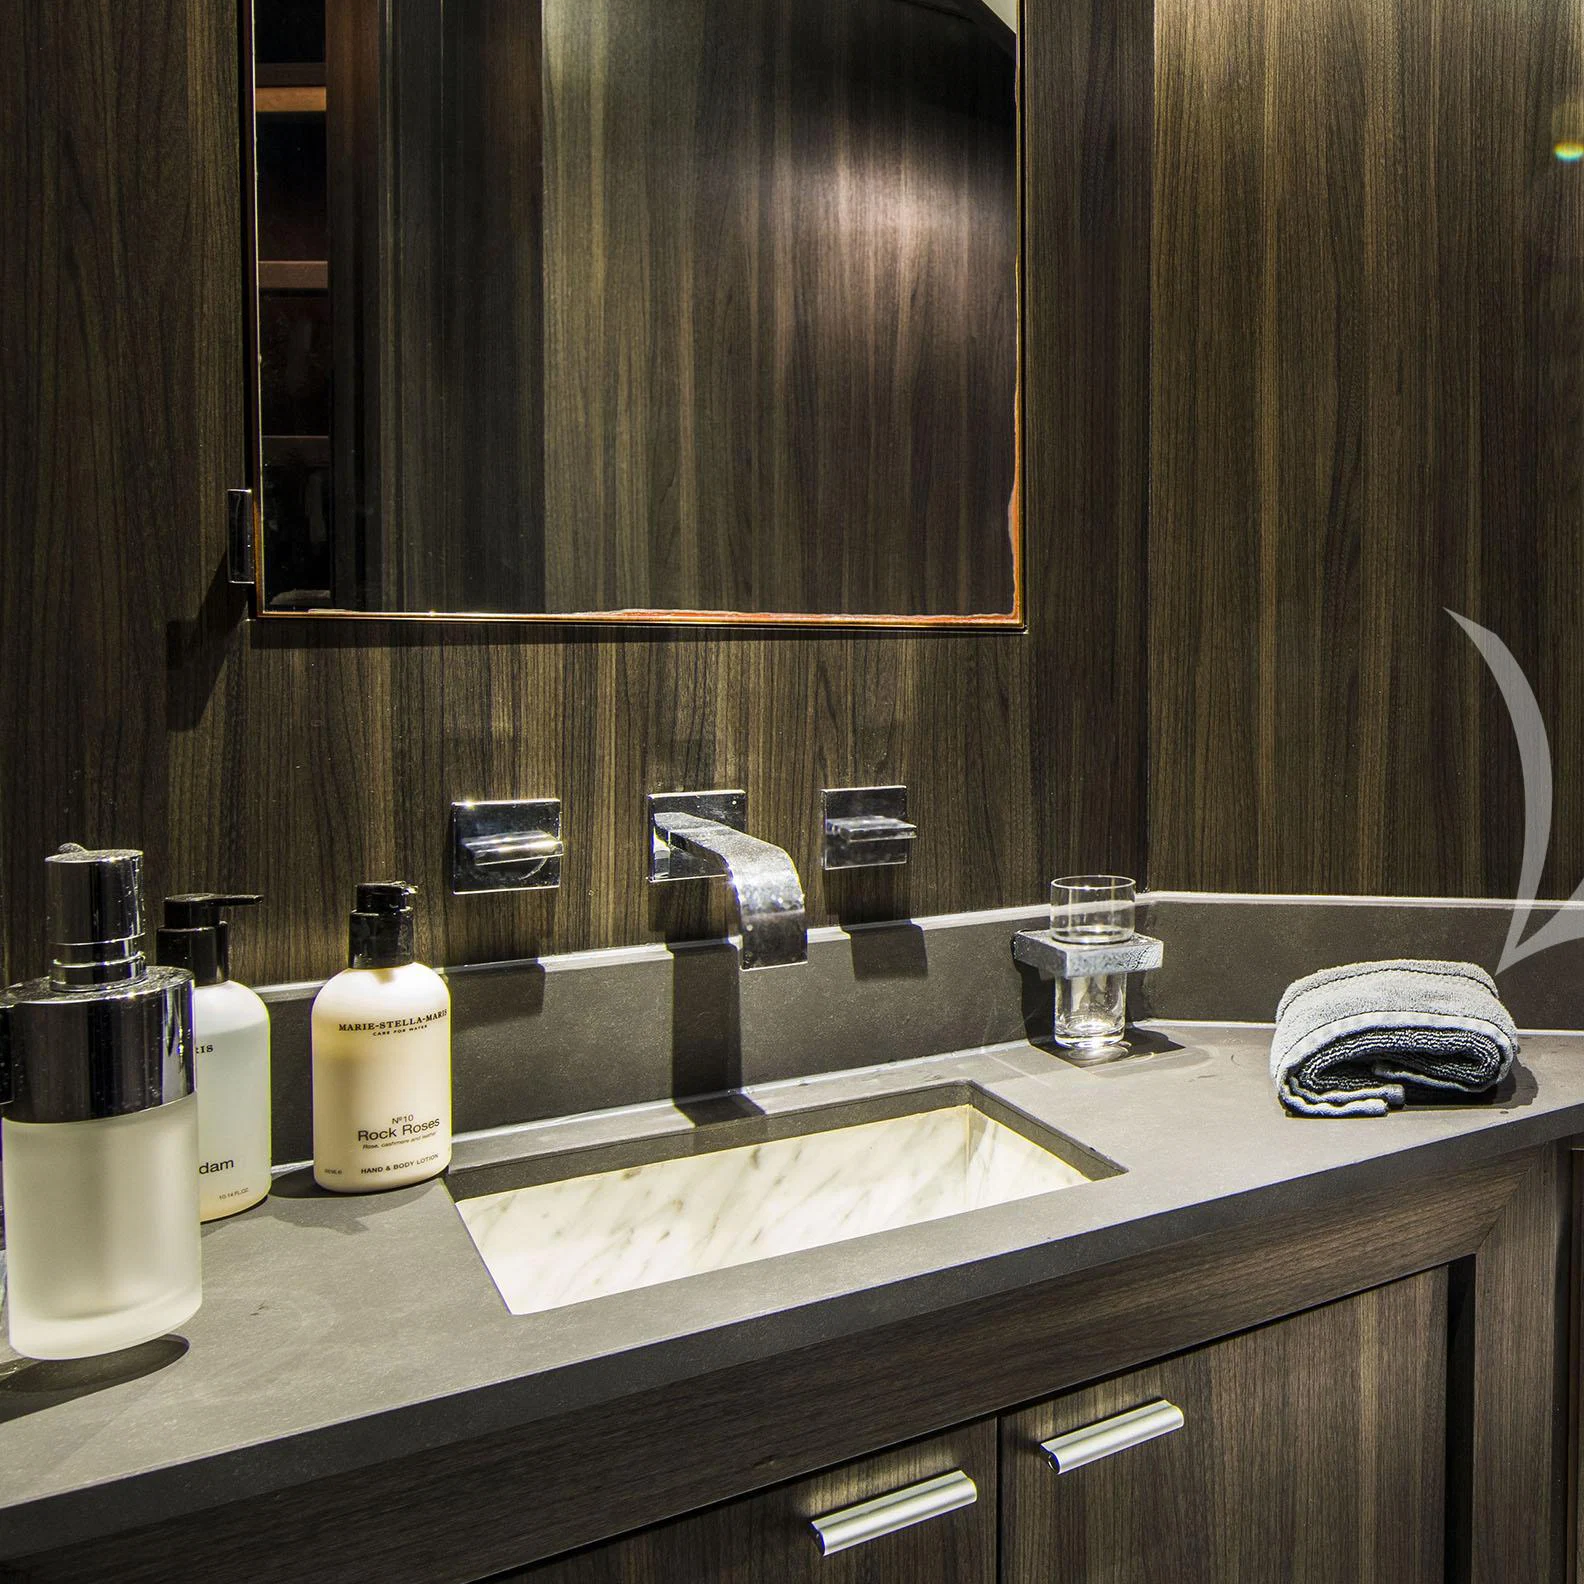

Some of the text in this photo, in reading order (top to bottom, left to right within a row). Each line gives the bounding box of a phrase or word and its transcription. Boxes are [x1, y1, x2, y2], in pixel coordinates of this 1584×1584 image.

[338, 1008, 447, 1031] MARIE-STELLA-MARIS
[358, 1118, 440, 1141] Rock Roses
[360, 1166, 384, 1174] HAND
[393, 1160, 415, 1170] BODY
[416, 1153, 440, 1165] LOTION
